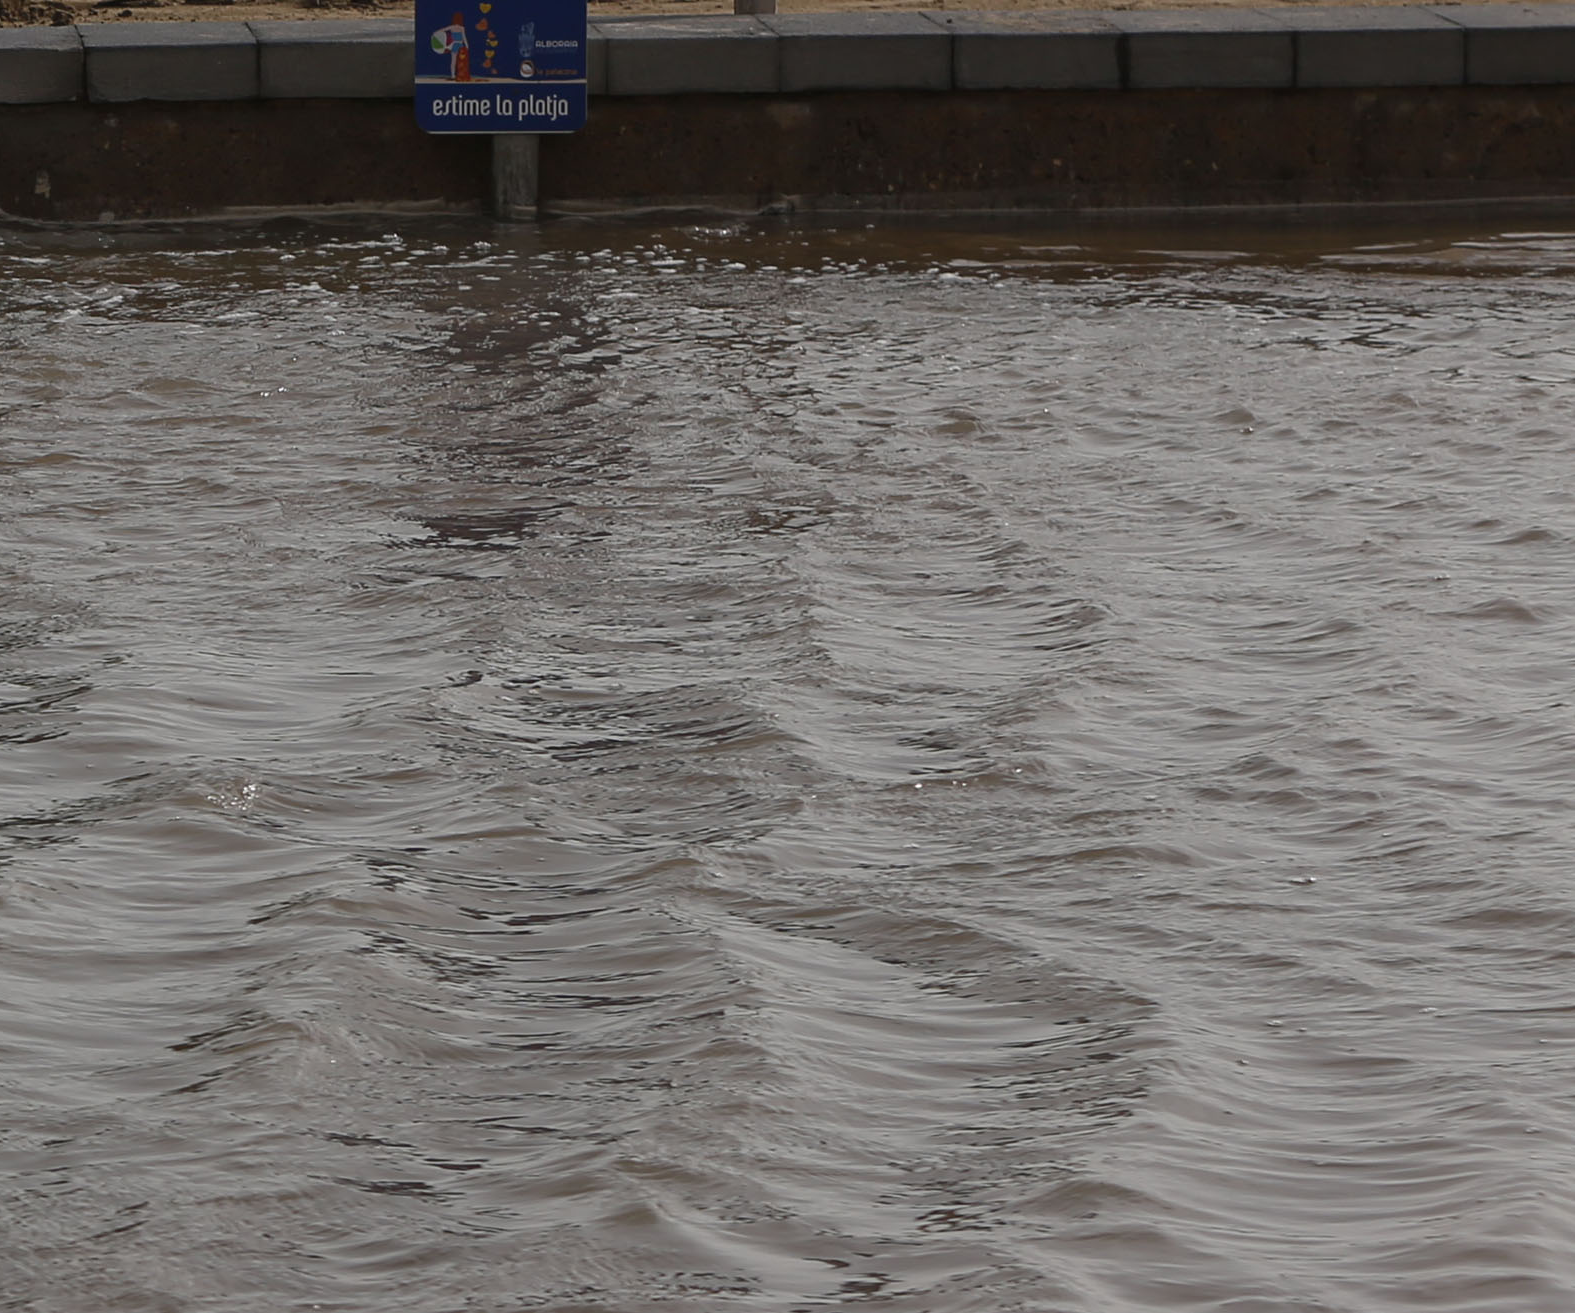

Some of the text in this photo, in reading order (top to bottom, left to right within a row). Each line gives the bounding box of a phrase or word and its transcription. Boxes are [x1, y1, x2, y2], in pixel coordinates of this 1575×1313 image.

[432, 94, 569, 121] estime la platja
